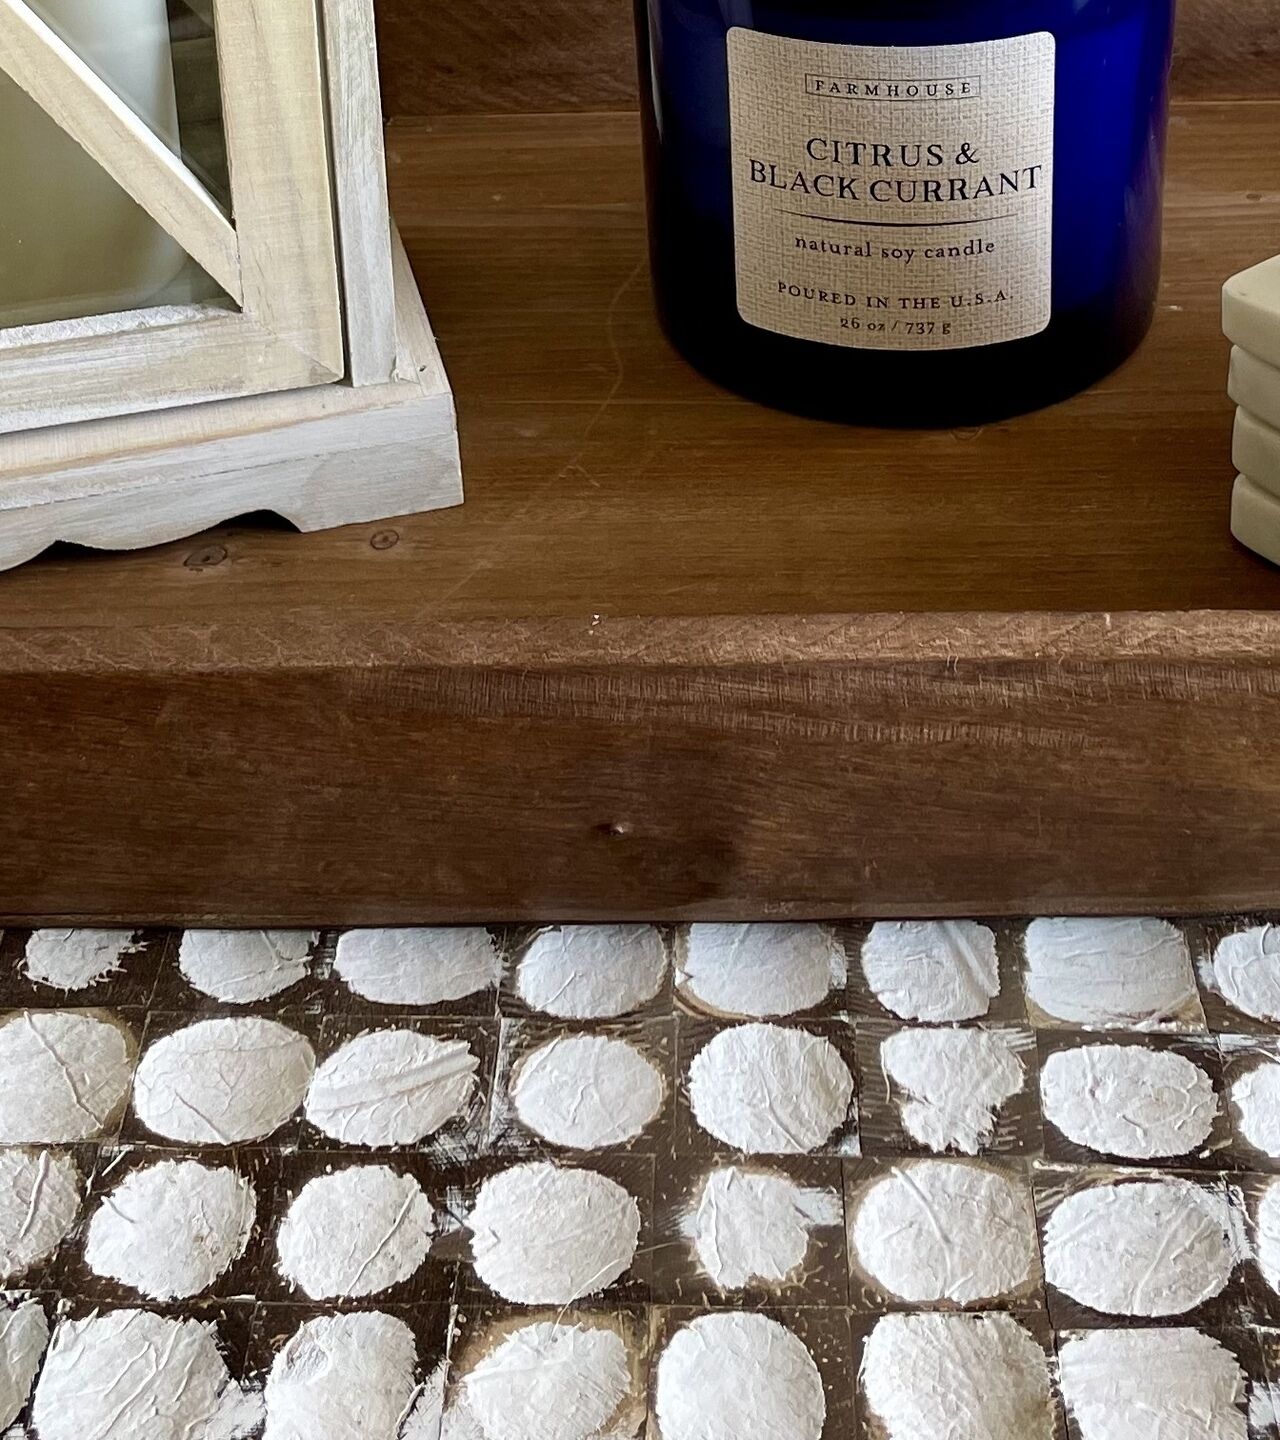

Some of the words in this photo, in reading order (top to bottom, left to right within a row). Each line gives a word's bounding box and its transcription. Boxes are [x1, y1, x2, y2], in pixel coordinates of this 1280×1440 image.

[814, 79, 972, 97] FARMHOUSE
[806, 137, 943, 167] CITRUS
[954, 142, 980, 165] &
[749, 159, 859, 201] BLACK
[869, 165, 1043, 203] CURRANT
[795, 236, 872, 258] natural
[880, 247, 915, 264] soy
[924, 239, 995, 259] candle
[778, 281, 857, 307] POURED
[866, 296, 890, 309] IN
[899, 297, 942, 310] THE
[951, 289, 1014, 308] U.S.A.
[840, 317, 861, 330] 26
[867, 322, 886, 331] oz
[905, 321, 935, 335] 737
[941, 322, 951, 335] g
